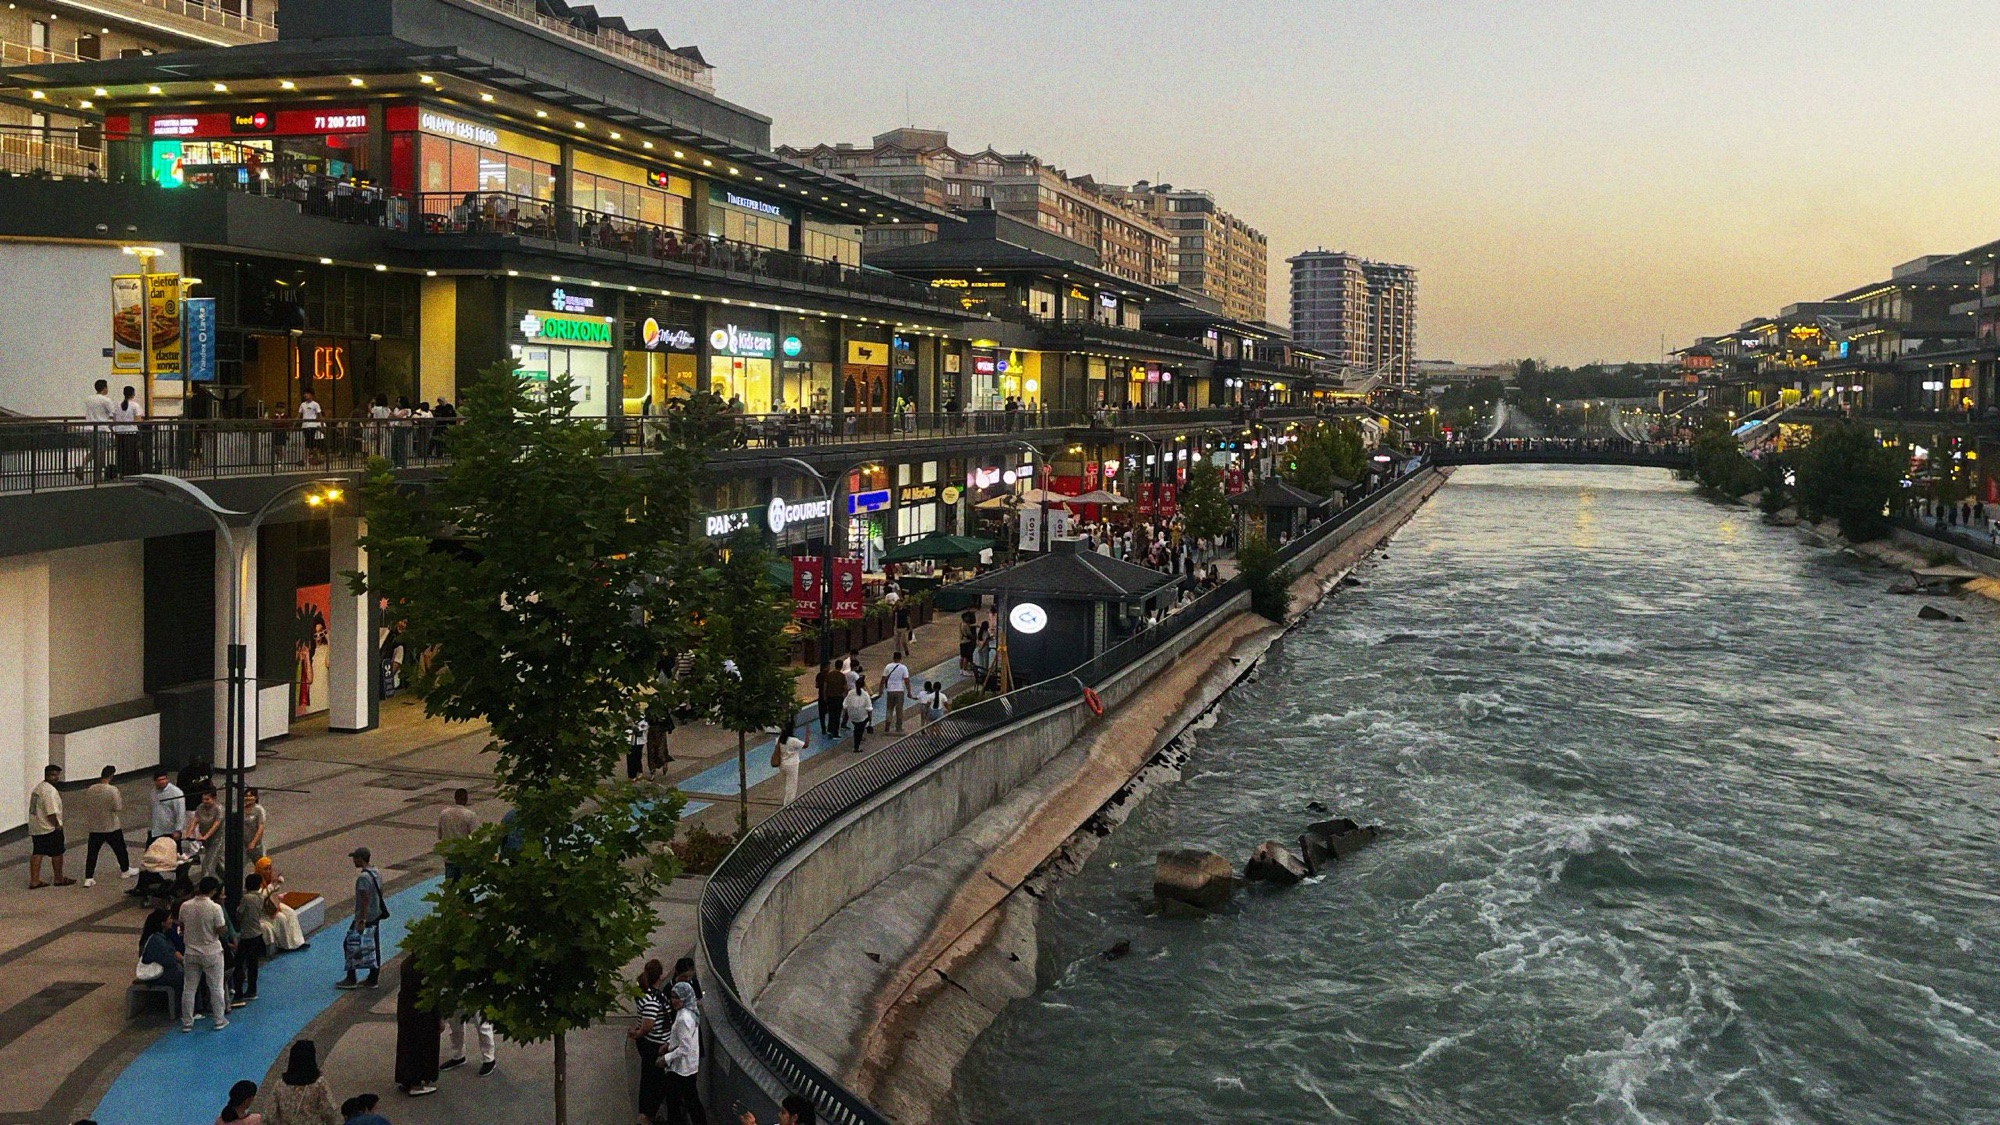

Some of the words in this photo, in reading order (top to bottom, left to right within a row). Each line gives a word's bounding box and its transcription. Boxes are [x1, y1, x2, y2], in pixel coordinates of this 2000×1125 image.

[314, 116, 325, 128] 71
[327, 116, 345, 128] 200
[346, 115, 366, 128] 2211
[475, 127, 497, 146] FOOD
[759, 200, 780, 216] LOUNGE
[149, 276, 179, 287] Telefon
[150, 288, 165, 298] dan
[156, 350, 179, 361] dastur
[199, 344, 207, 372] Yandex
[157, 362, 179, 372] xonga
[785, 500, 832, 523] GOURMET
[1028, 517, 1036, 541] COSTA
[836, 601, 859, 610] KFC
